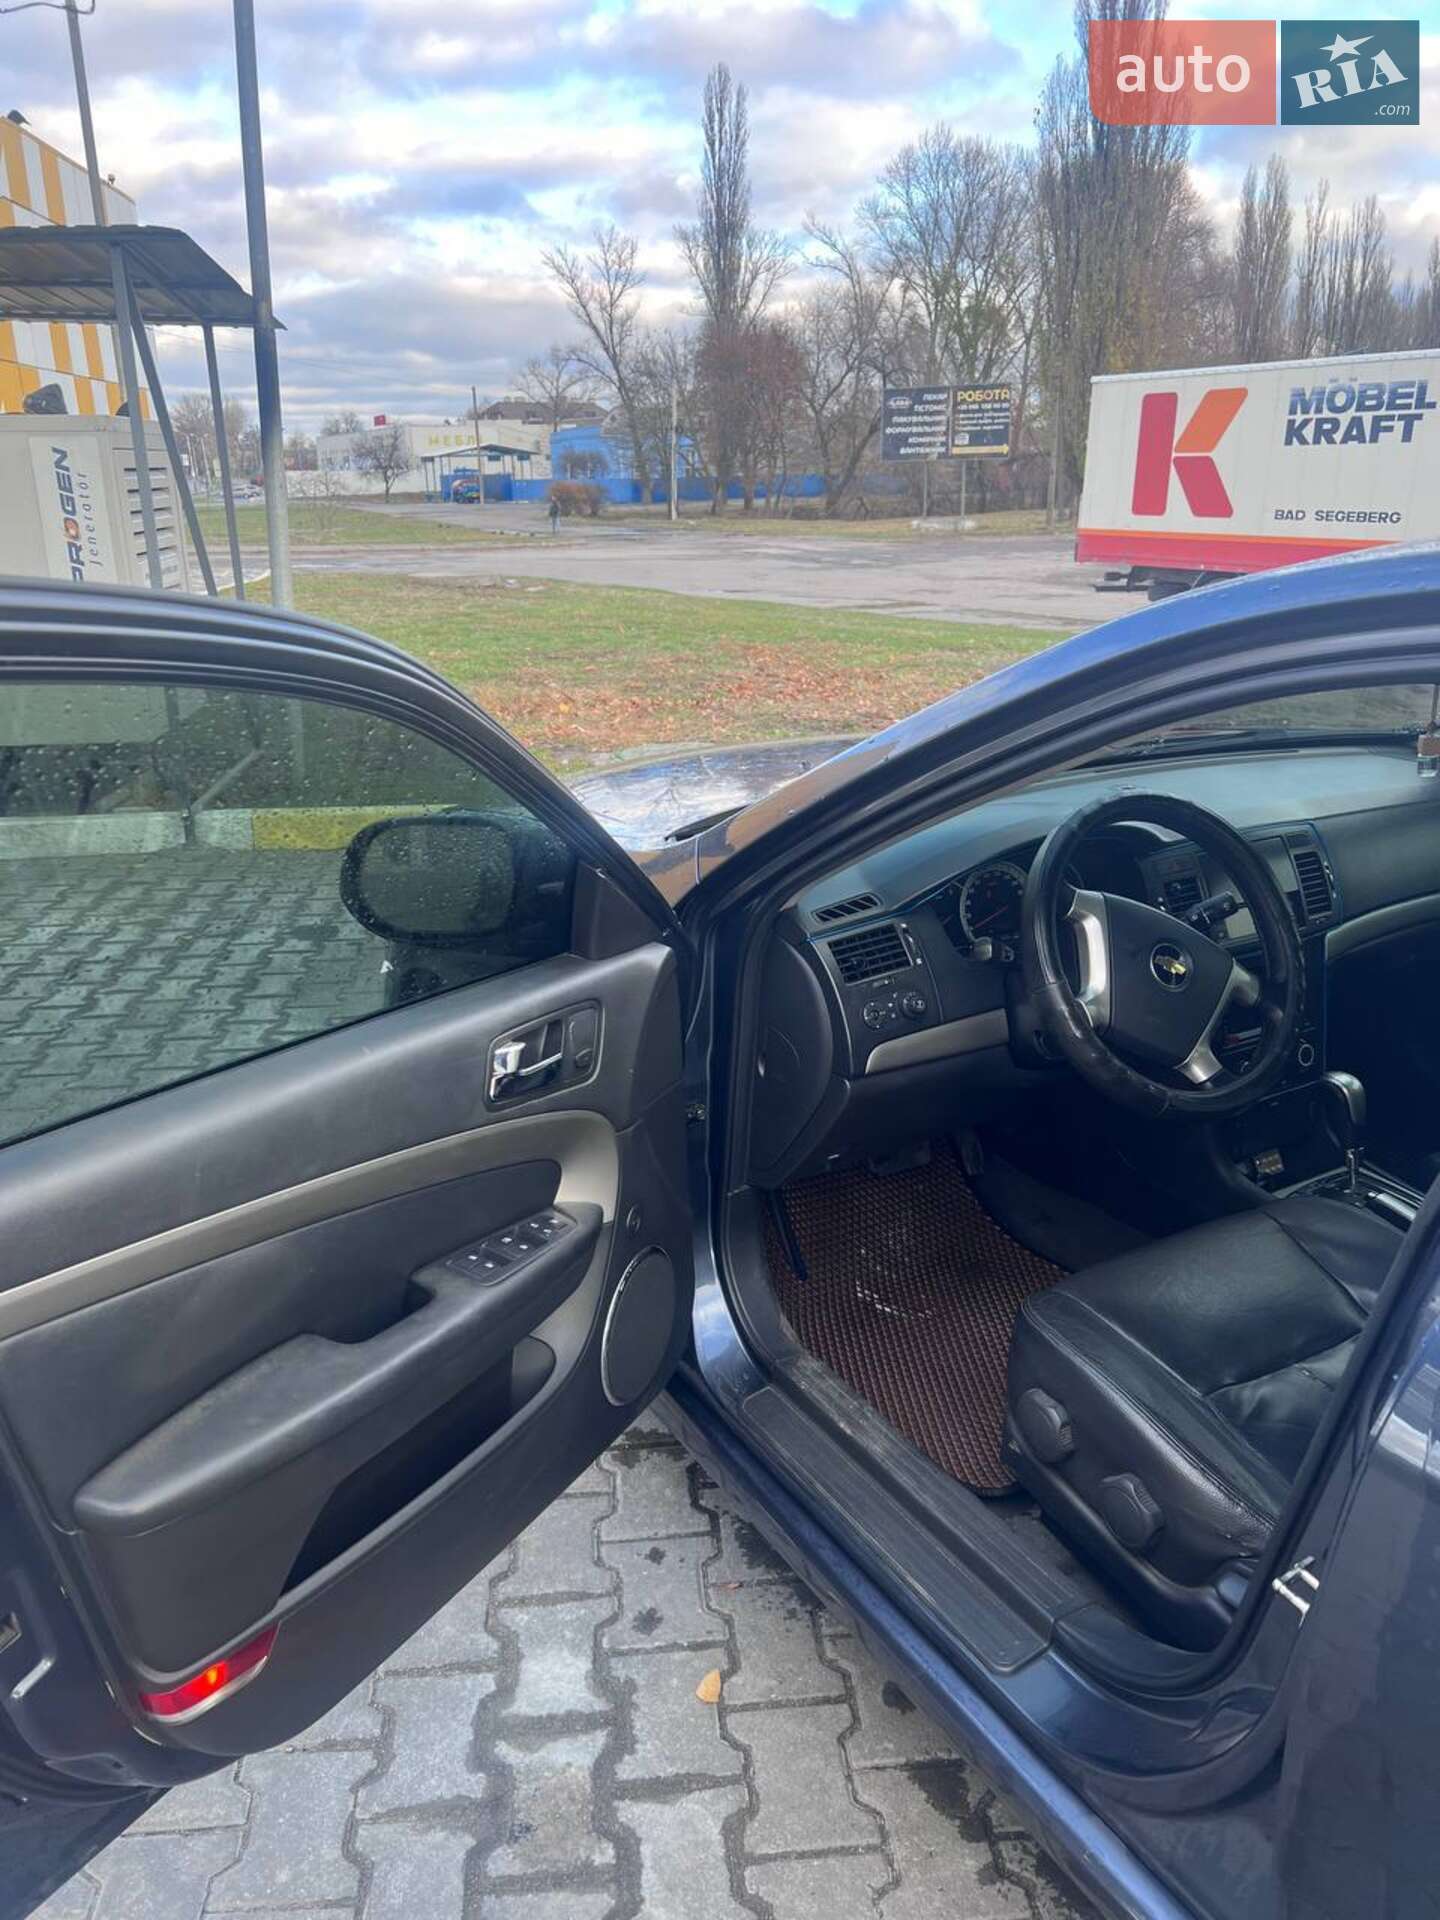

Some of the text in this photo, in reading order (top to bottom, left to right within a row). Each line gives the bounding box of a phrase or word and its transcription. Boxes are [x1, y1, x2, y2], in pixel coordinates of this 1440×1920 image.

[957, 389, 1009, 402] РОБОТА
[1288, 377, 1437, 415] MÖBEL
[1284, 413, 1424, 446] KRAFT
[51, 446, 86, 582] PROGEN
[1274, 509, 1402, 524] BAD SEGEBERG
